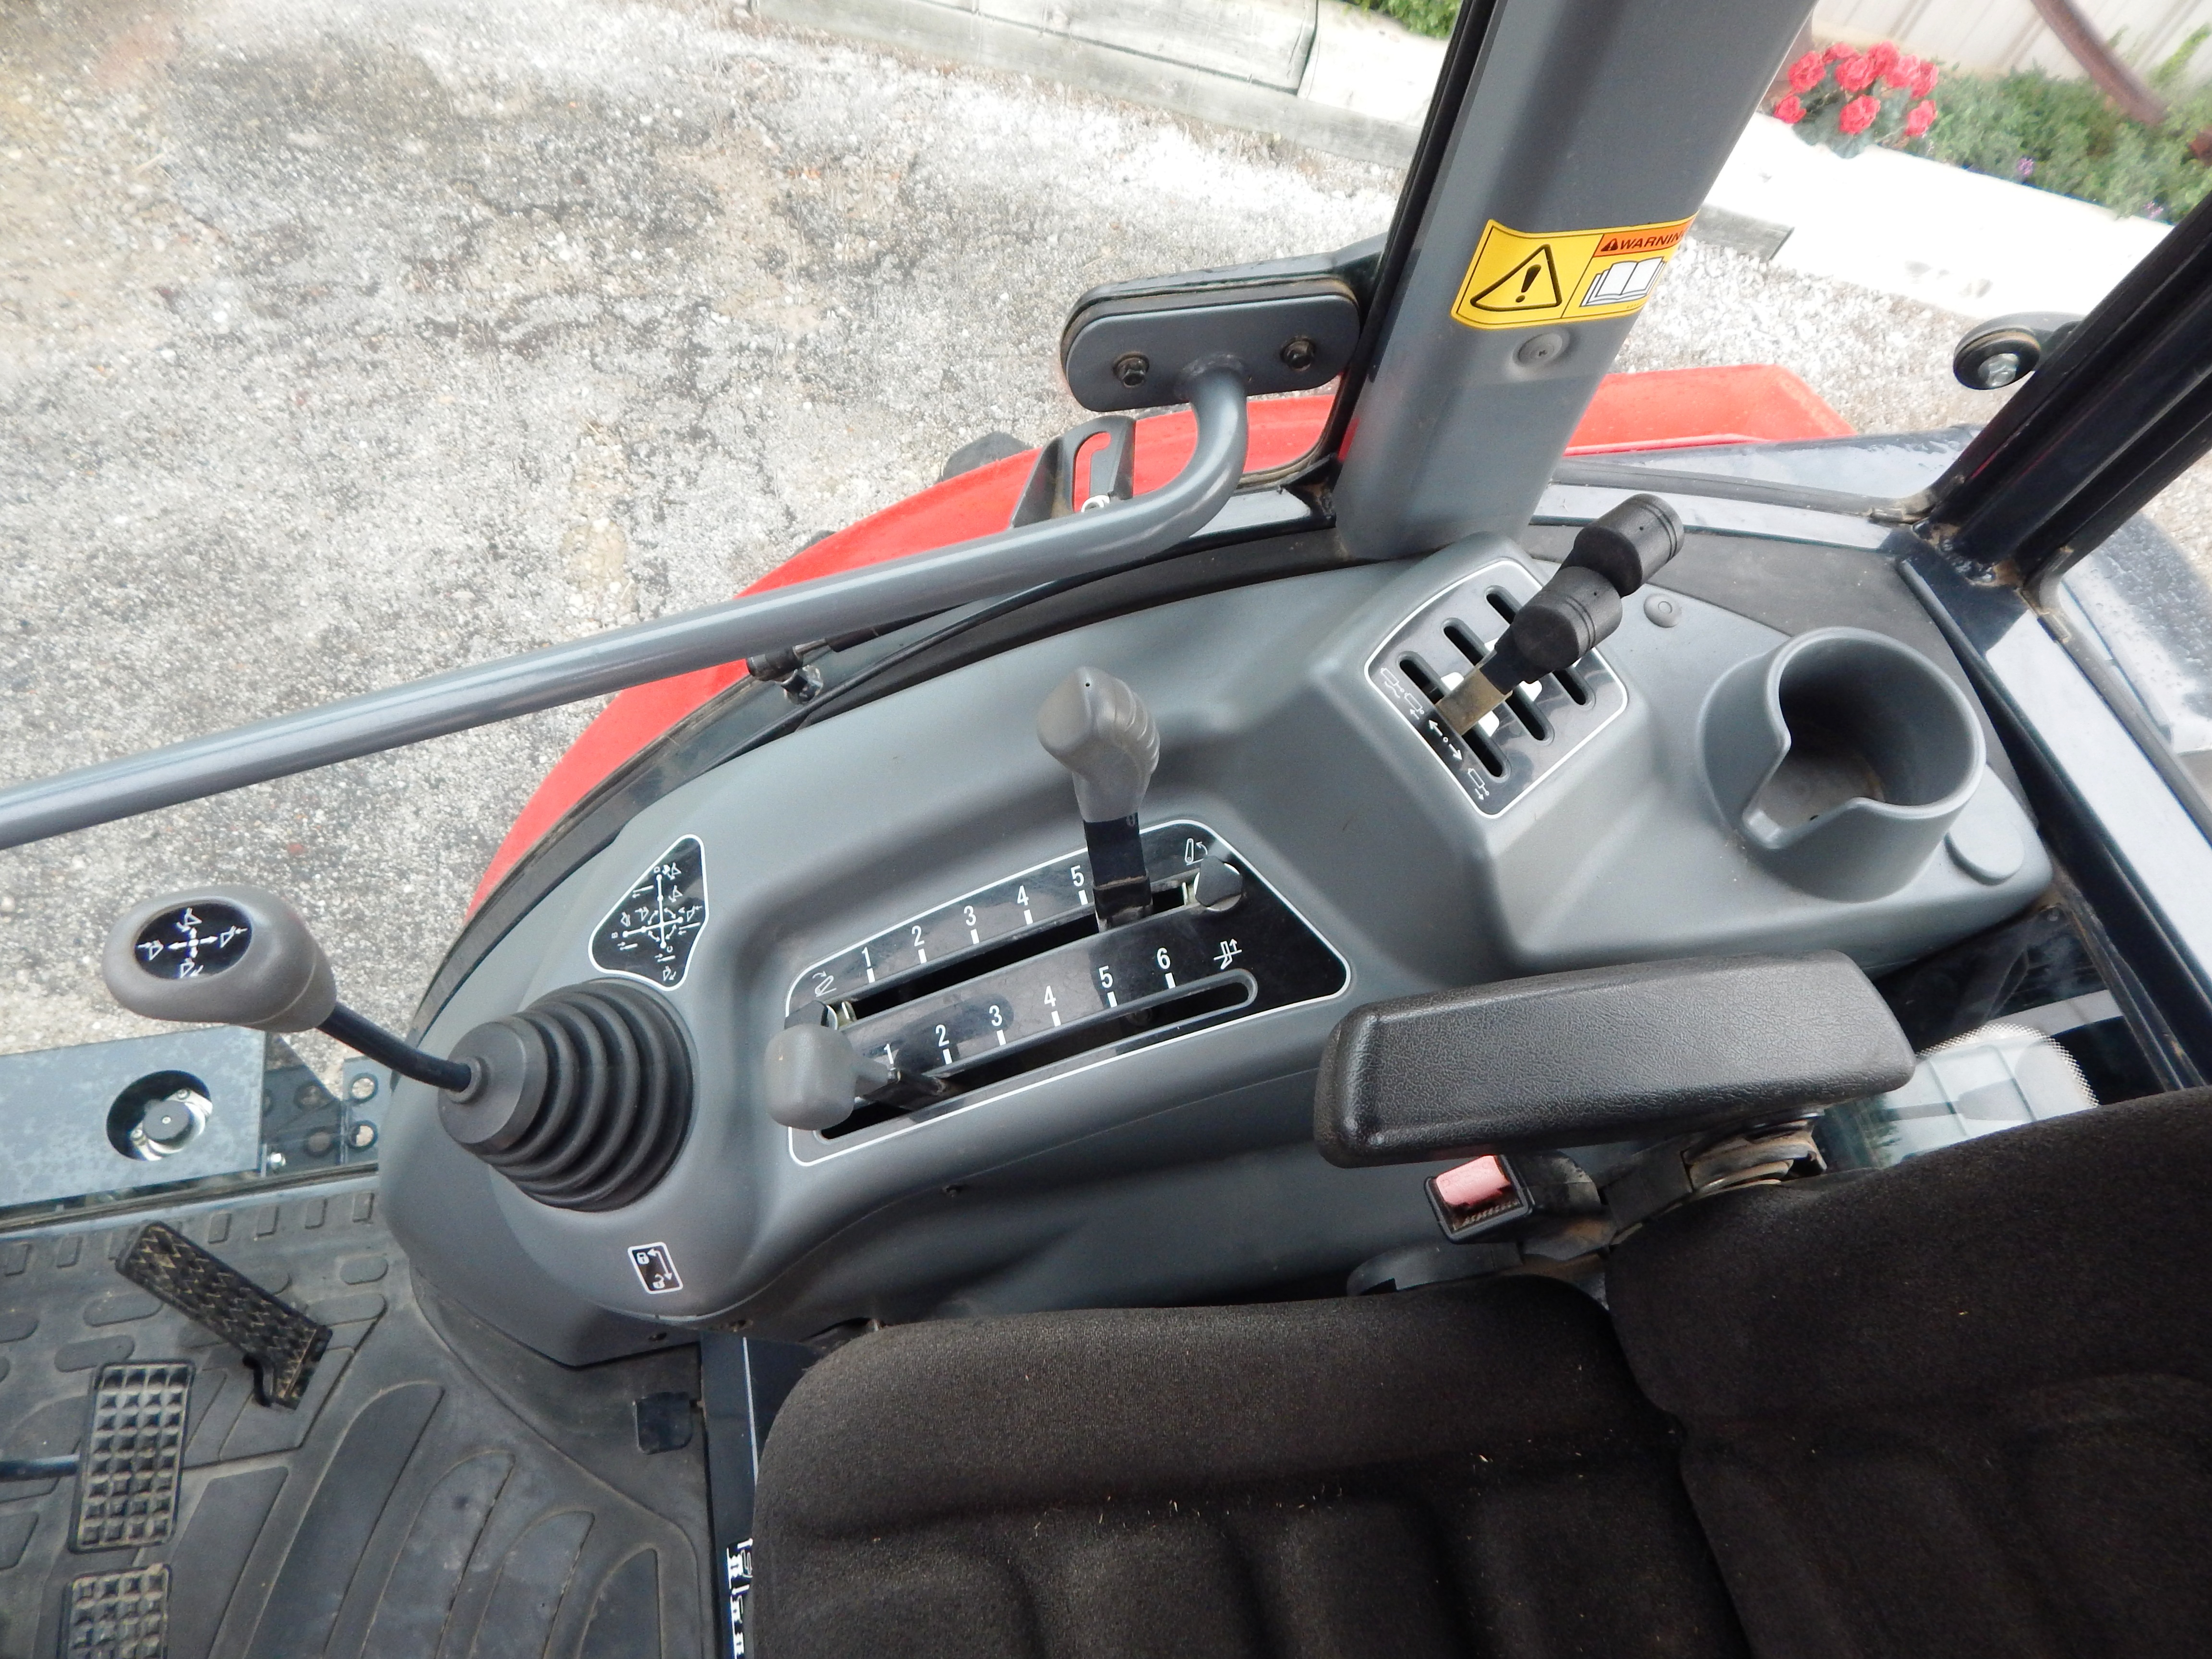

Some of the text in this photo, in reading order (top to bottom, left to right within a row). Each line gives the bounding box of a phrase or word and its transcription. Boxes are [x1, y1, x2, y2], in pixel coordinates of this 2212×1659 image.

[1620, 229, 1685, 250] WARNIN
[862, 865, 1084, 967] 1 2 3 4 5
[884, 948, 1171, 1064] 1 2 3 4 5 6
